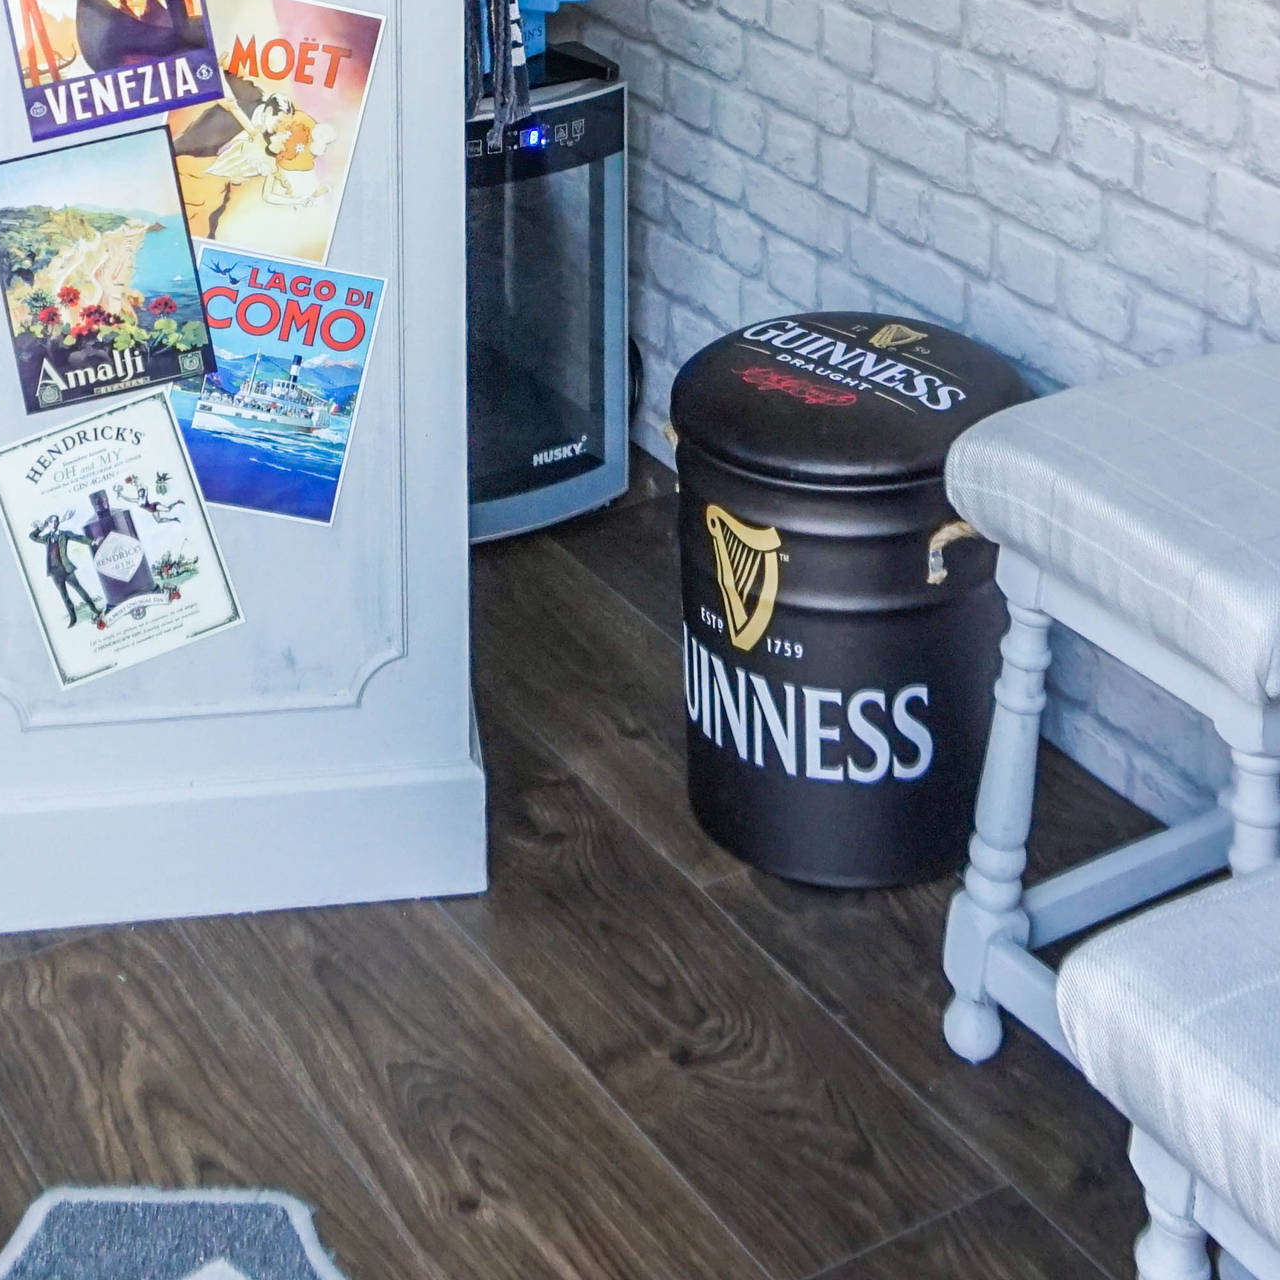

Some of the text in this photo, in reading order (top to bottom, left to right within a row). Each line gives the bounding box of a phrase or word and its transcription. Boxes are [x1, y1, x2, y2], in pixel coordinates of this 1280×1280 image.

[44, 56, 200, 126] VENEZIA
[247, 266, 374, 310] LAGO DI
[201, 285, 366, 353] COMO
[36, 348, 146, 397] Amalfi
[742, 319, 966, 412] GUINNESS
[775, 353, 873, 392] DRAUGHT
[25, 425, 145, 486] HENDRICK'S
[533, 442, 583, 467] HUSKY
[766, 637, 804, 659] 1759
[683, 620, 934, 784] UINNESS
